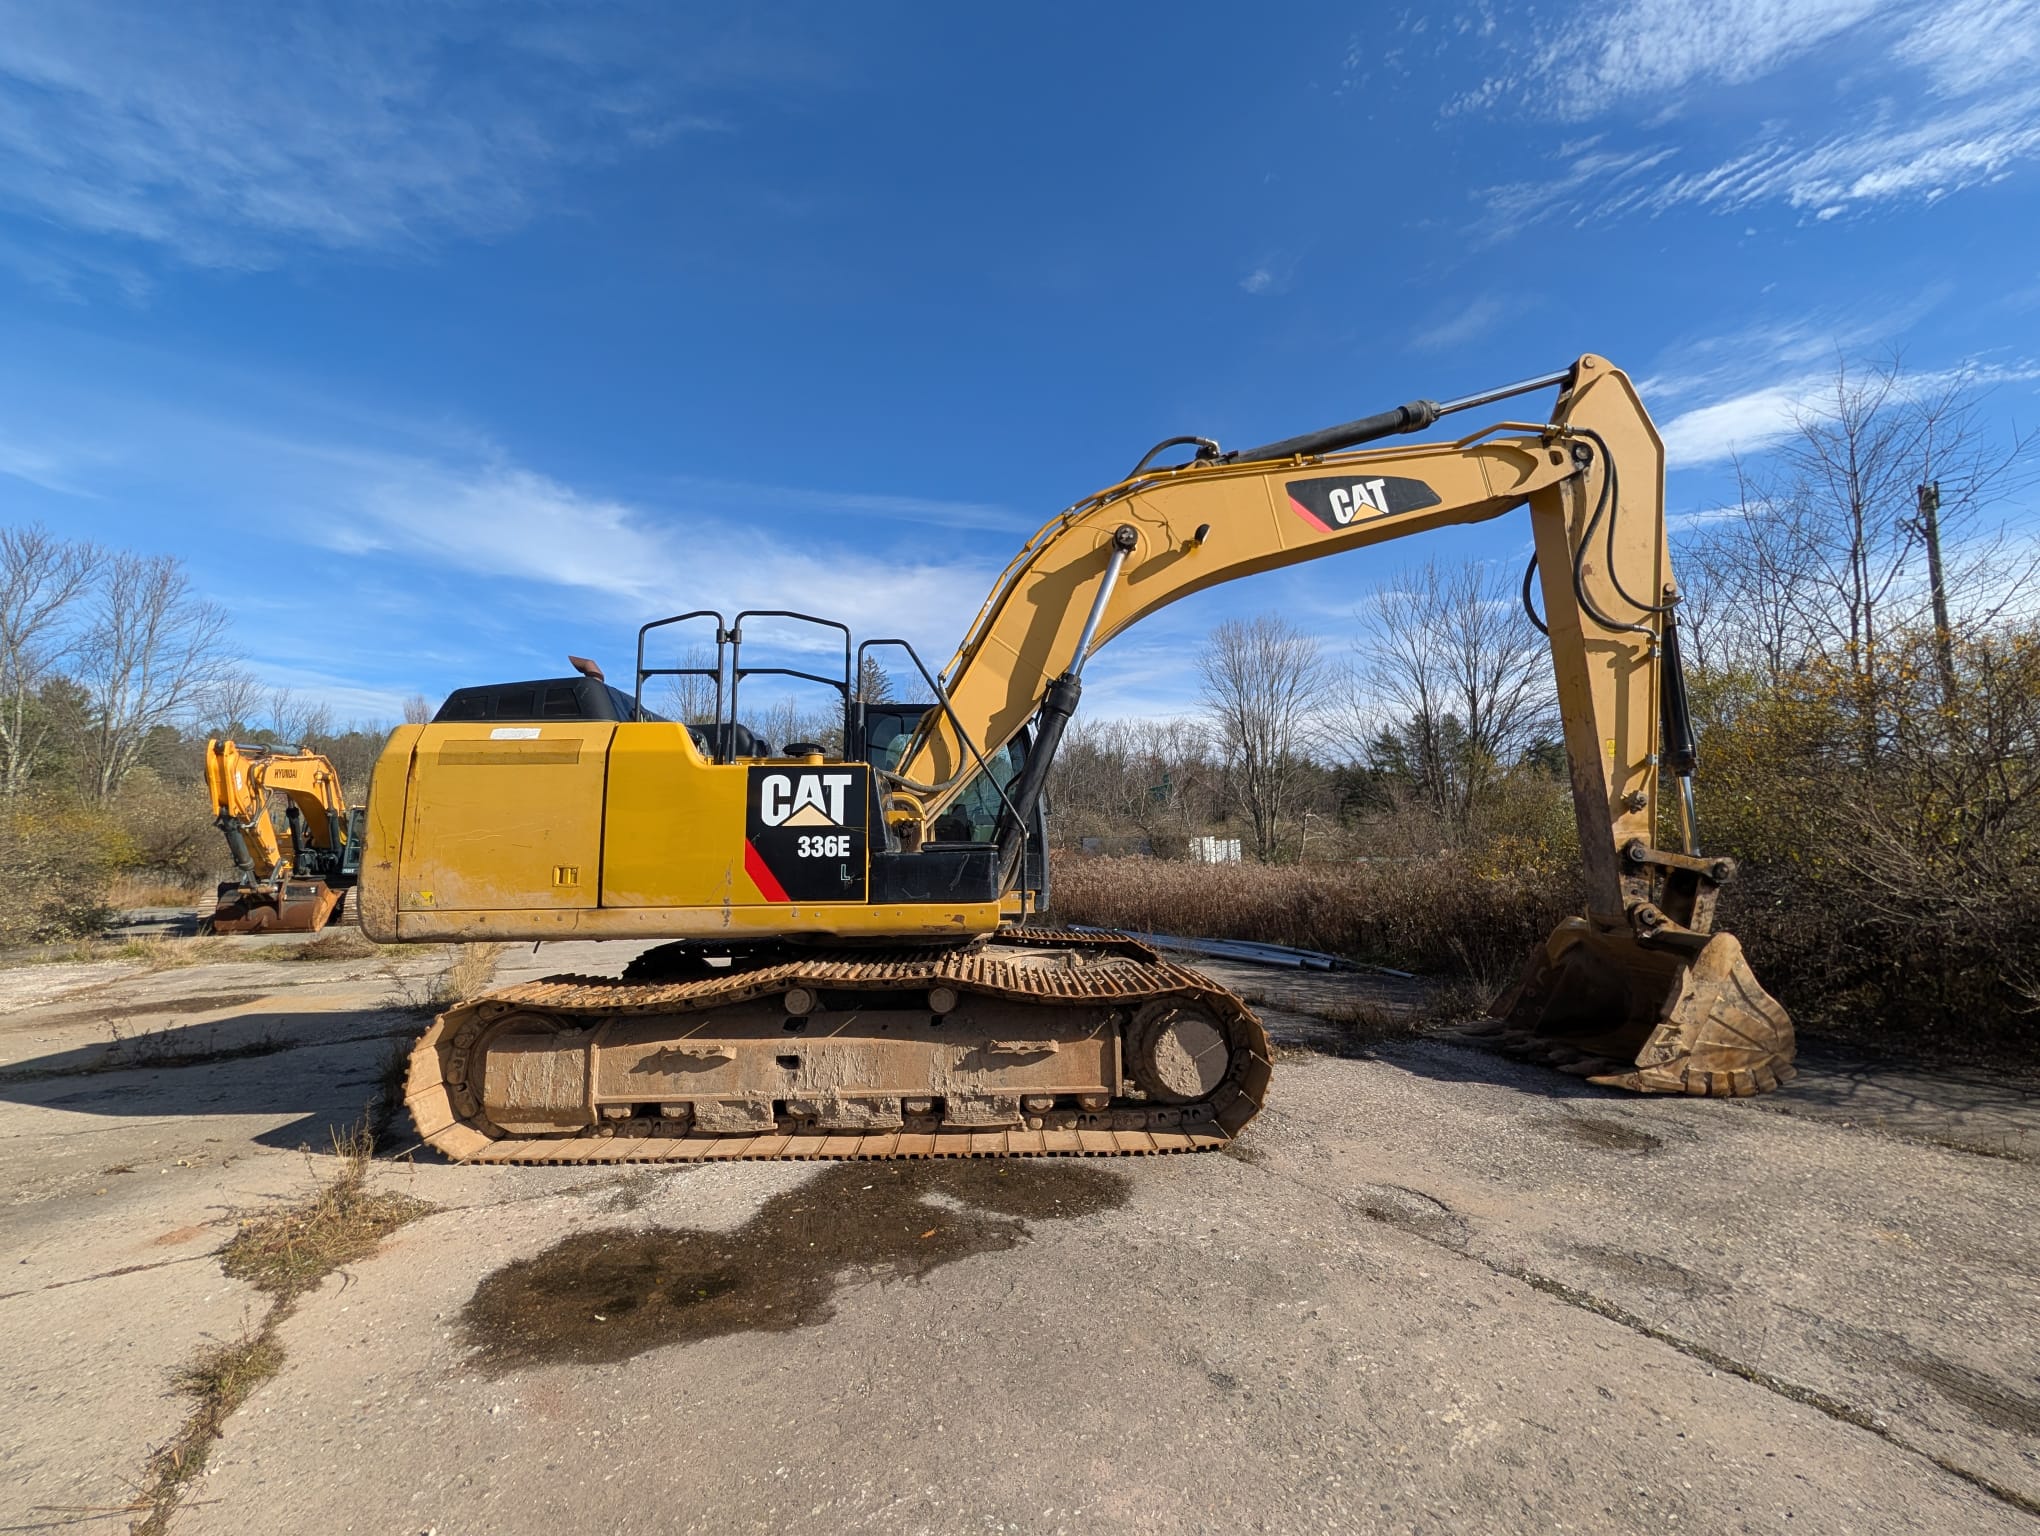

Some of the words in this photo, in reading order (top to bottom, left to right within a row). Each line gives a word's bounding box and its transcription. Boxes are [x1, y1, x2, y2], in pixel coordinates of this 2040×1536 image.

[1329, 479, 1389, 524] CAT
[274, 768, 297, 778] HYUNDAI
[761, 774, 852, 827] CAT
[797, 835, 850, 858] 336E
